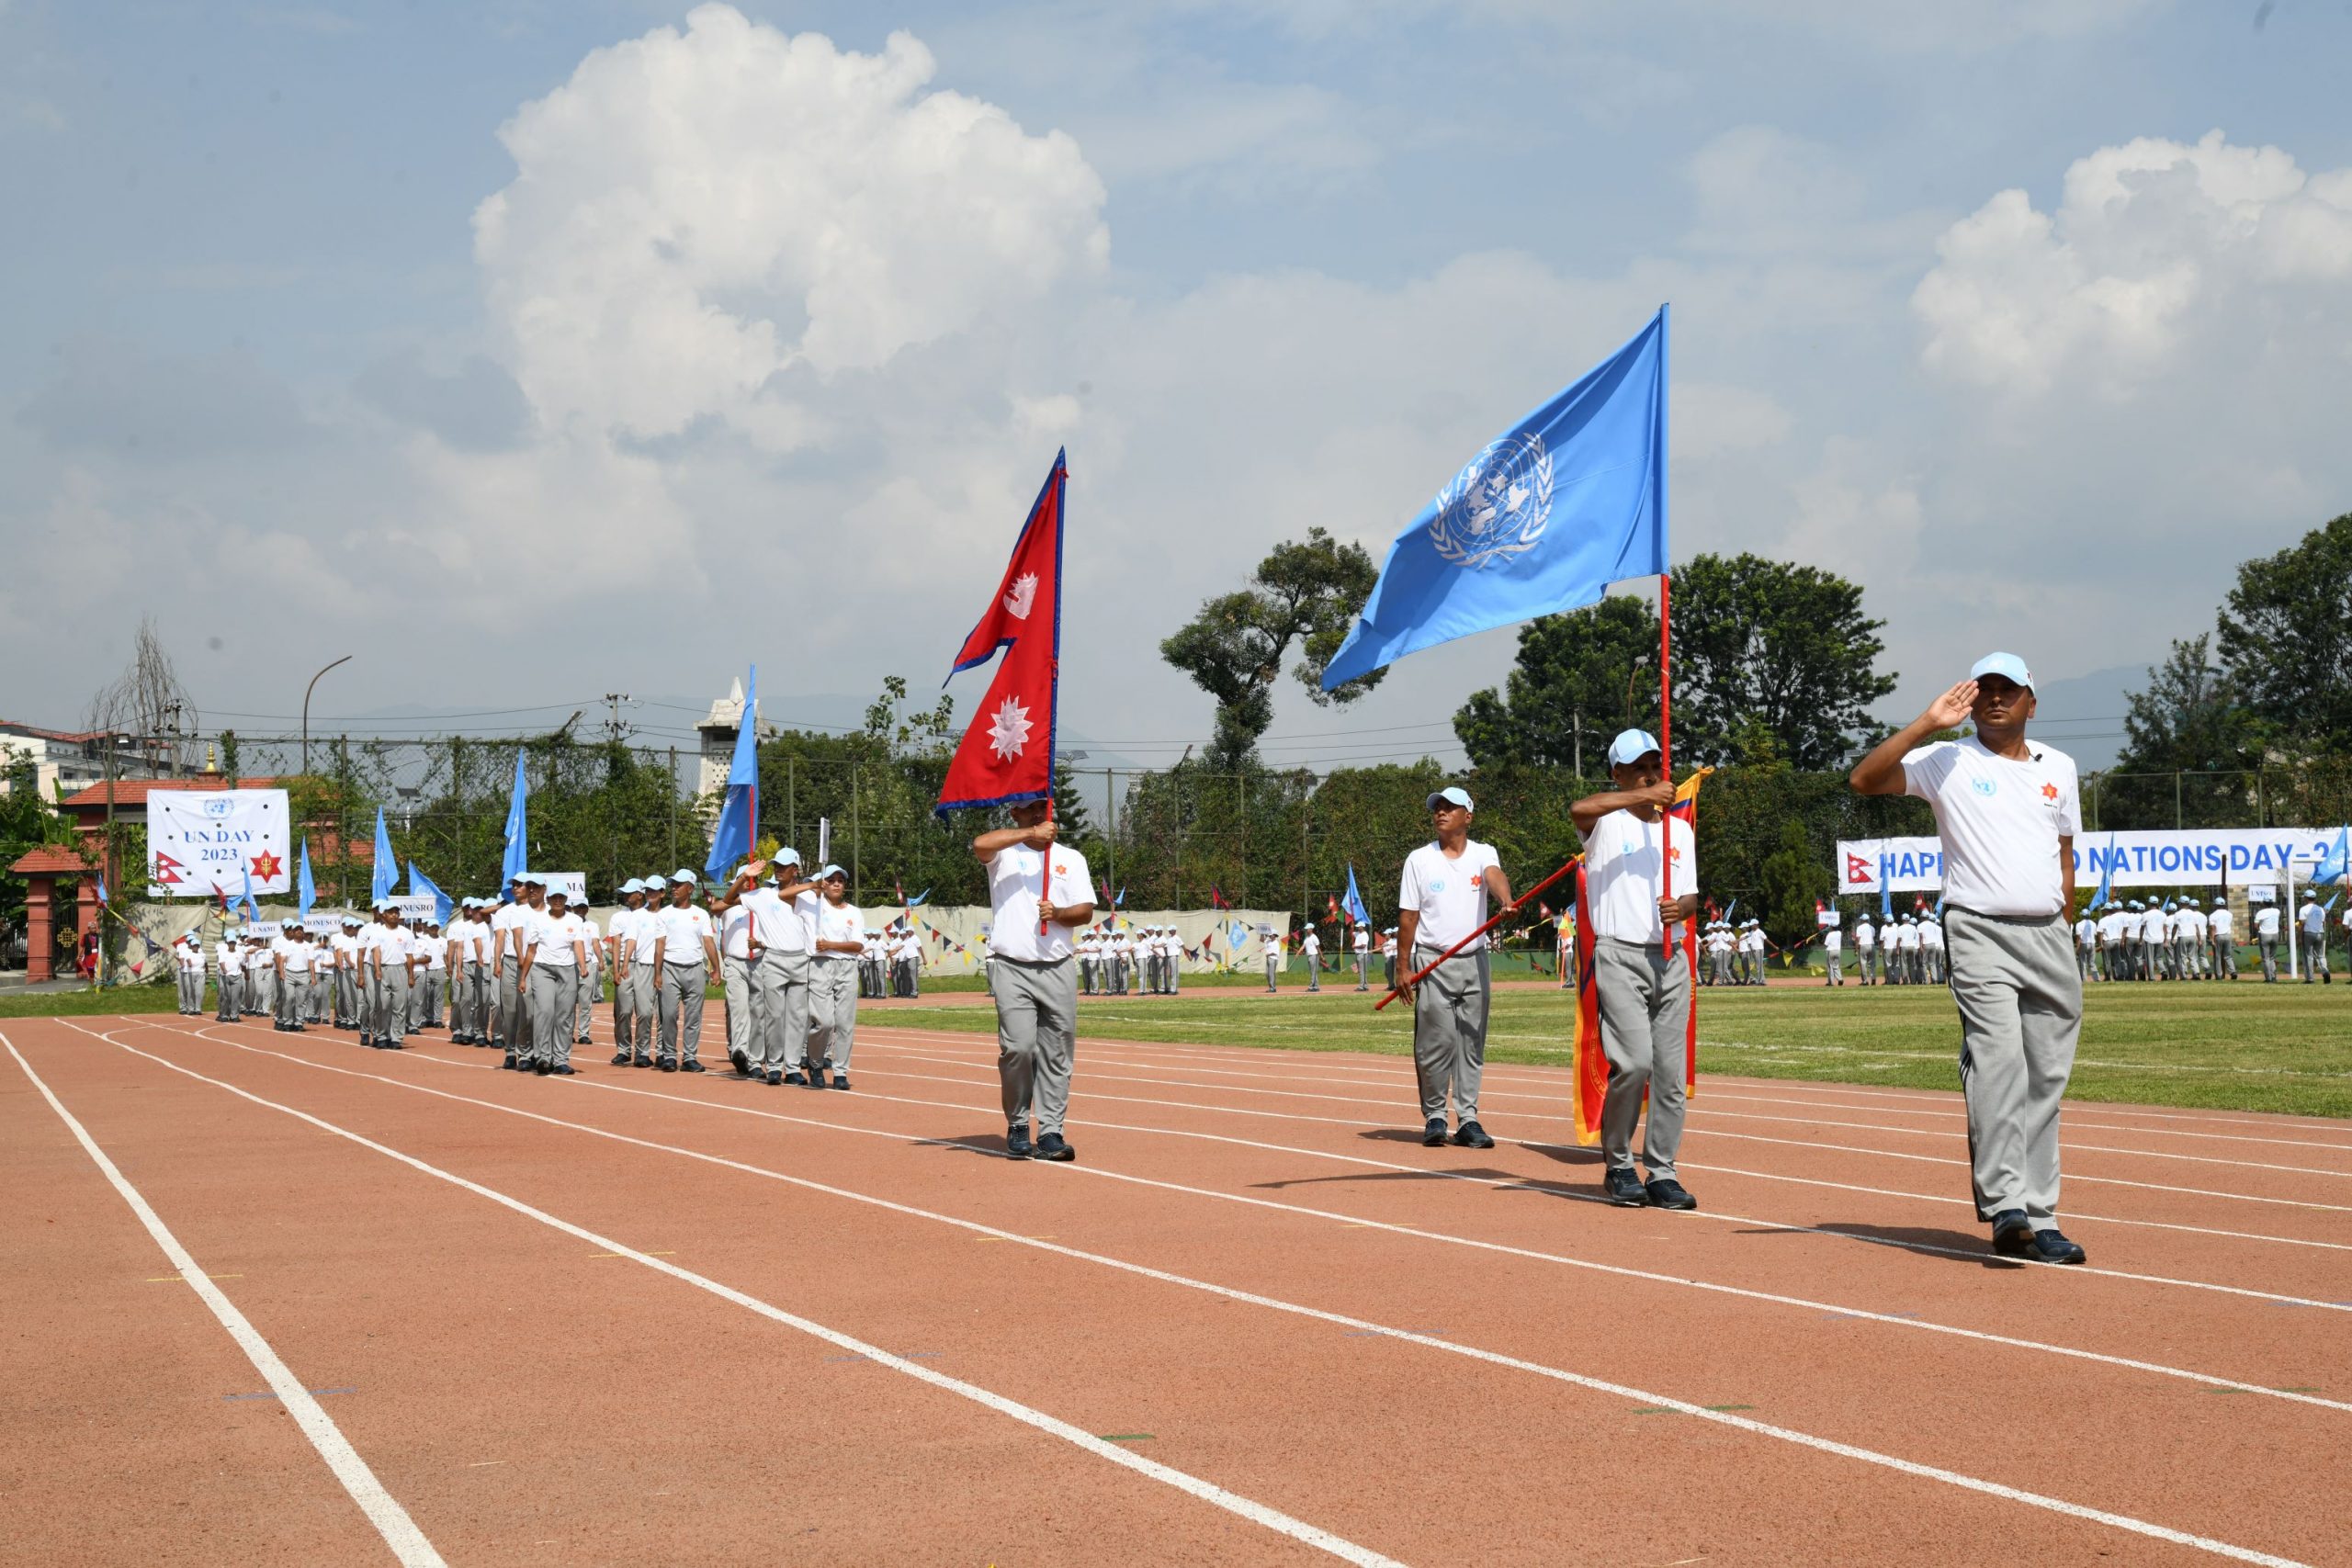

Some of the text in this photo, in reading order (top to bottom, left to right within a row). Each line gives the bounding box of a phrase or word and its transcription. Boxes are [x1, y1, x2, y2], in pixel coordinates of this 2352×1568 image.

[185, 829, 254, 843] UN DAY
[201, 848, 238, 861] 2023
[1880, 852, 1943, 878] HAP
[2089, 844, 2222, 873] NATIONS
[2231, 841, 2350, 871] DAY-2
[400, 904, 434, 912] INUSRO
[303, 919, 341, 927] MONUSCO
